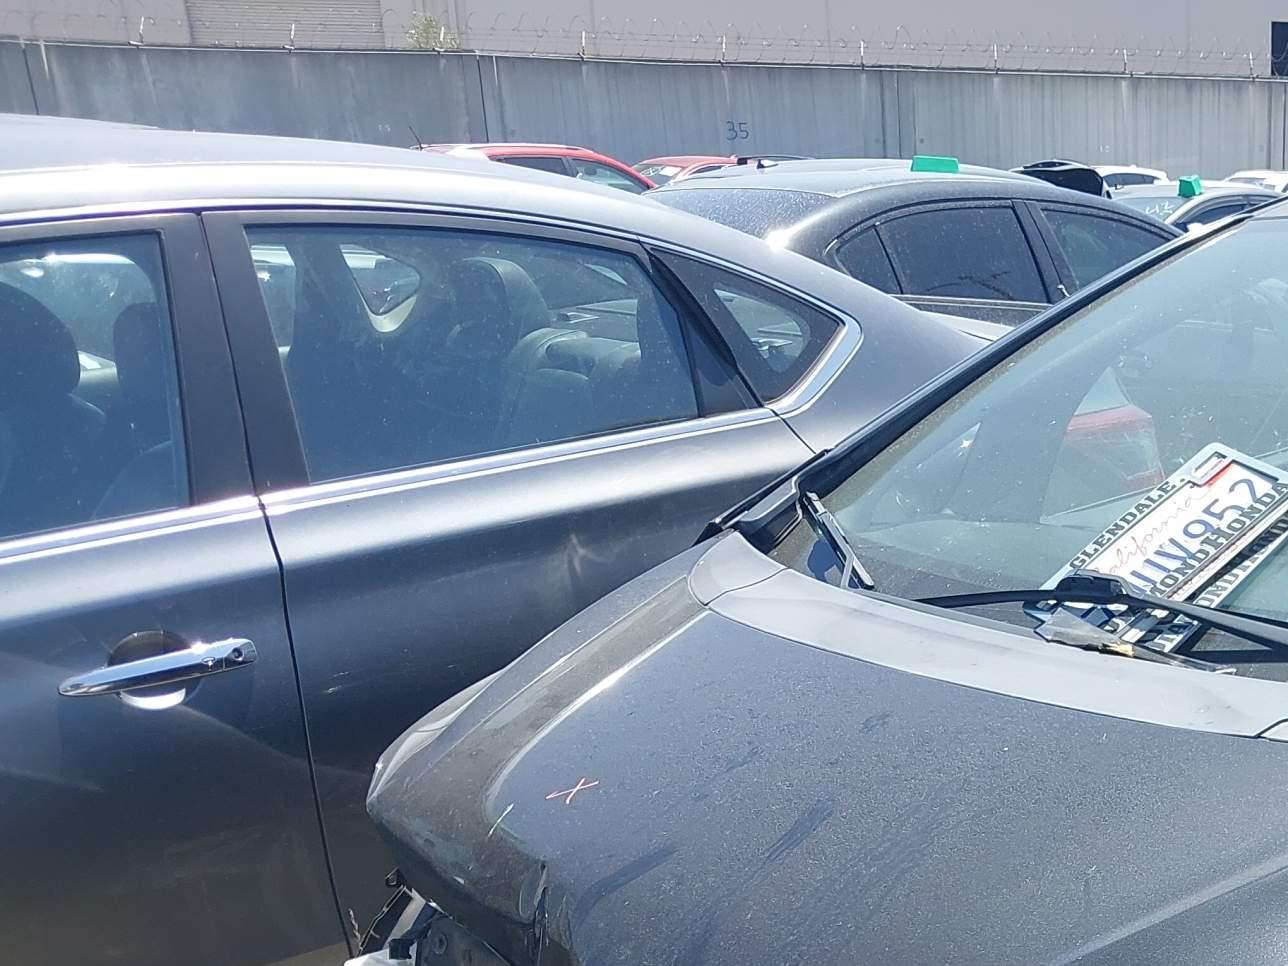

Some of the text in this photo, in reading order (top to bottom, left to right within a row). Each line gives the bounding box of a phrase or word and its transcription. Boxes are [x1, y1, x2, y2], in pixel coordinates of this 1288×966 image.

[726, 120, 749, 141] 35
[1069, 480, 1177, 570] GLENDALE
[1104, 497, 1194, 577] alifornia
